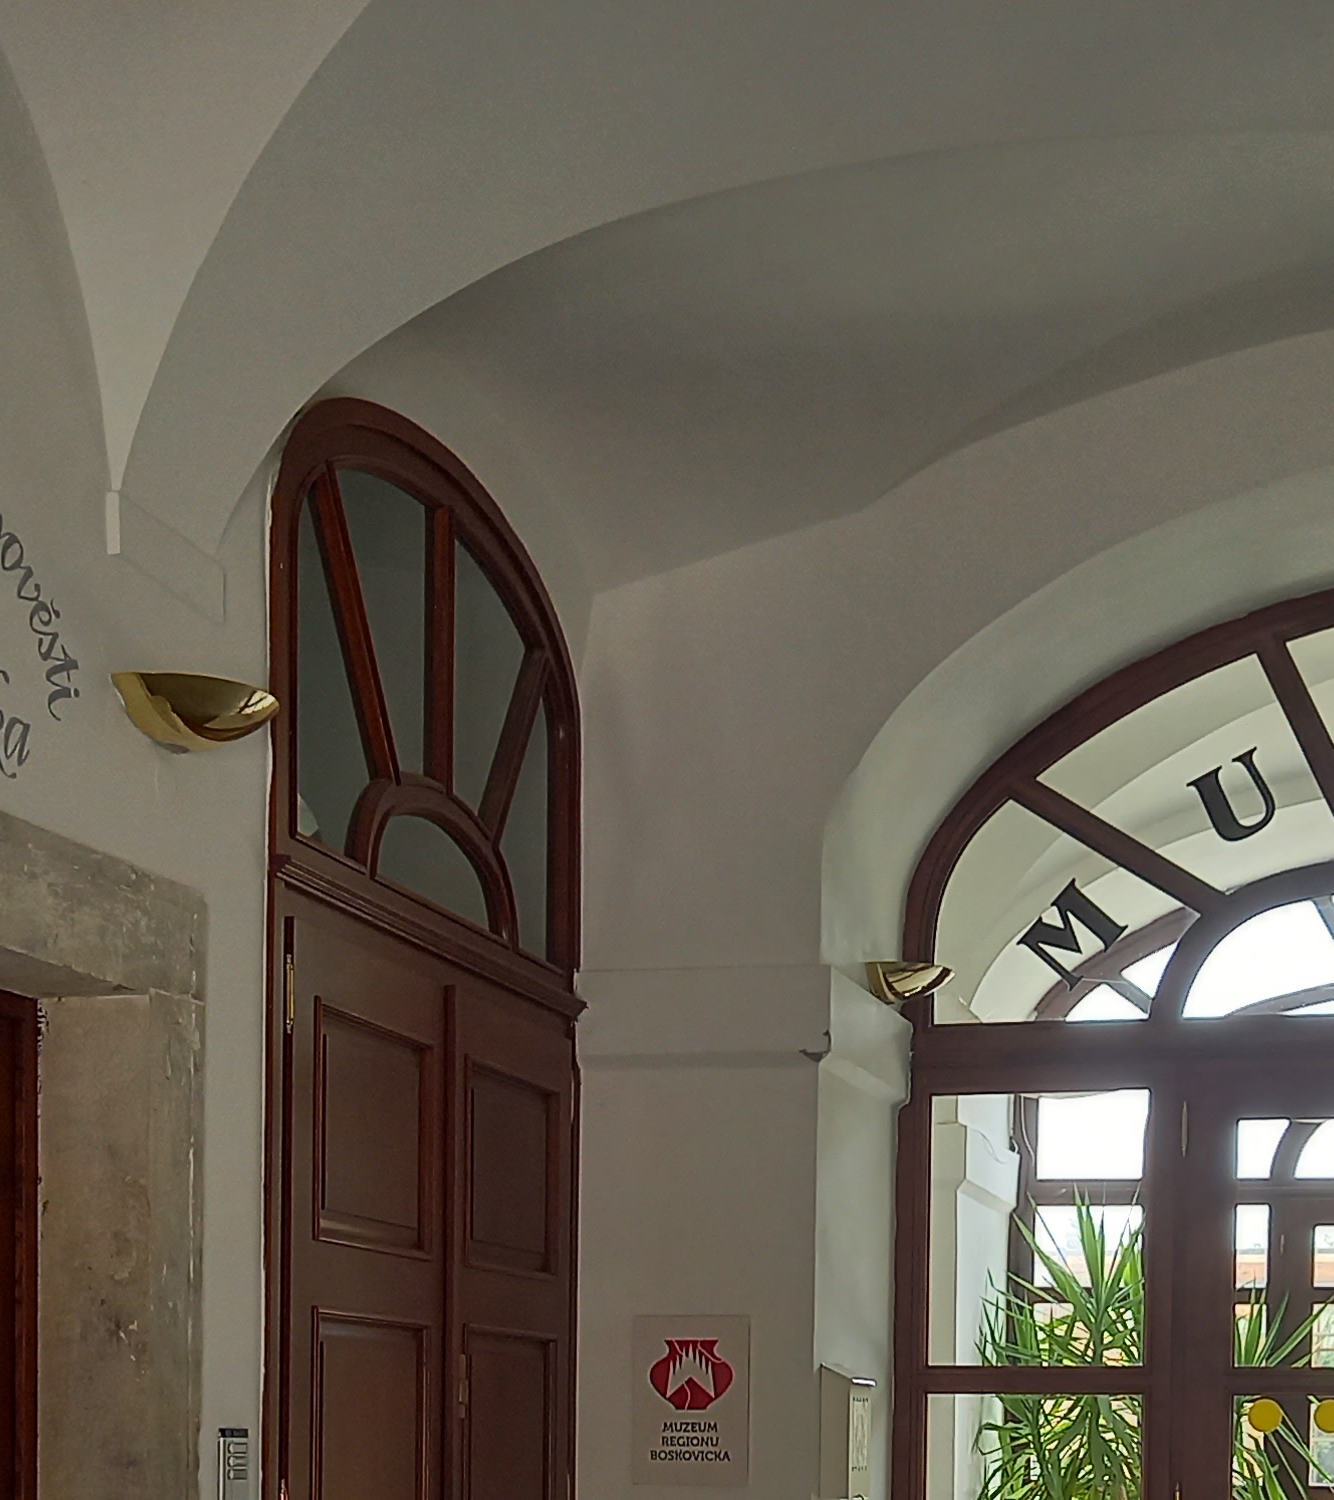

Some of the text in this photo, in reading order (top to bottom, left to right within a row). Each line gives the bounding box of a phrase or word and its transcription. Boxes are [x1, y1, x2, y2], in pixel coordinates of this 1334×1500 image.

[662, 1421, 718, 1433] MUZEUM
[661, 1435, 719, 1447] REGIONU
[650, 1449, 731, 1462] BOSKOVICKA
